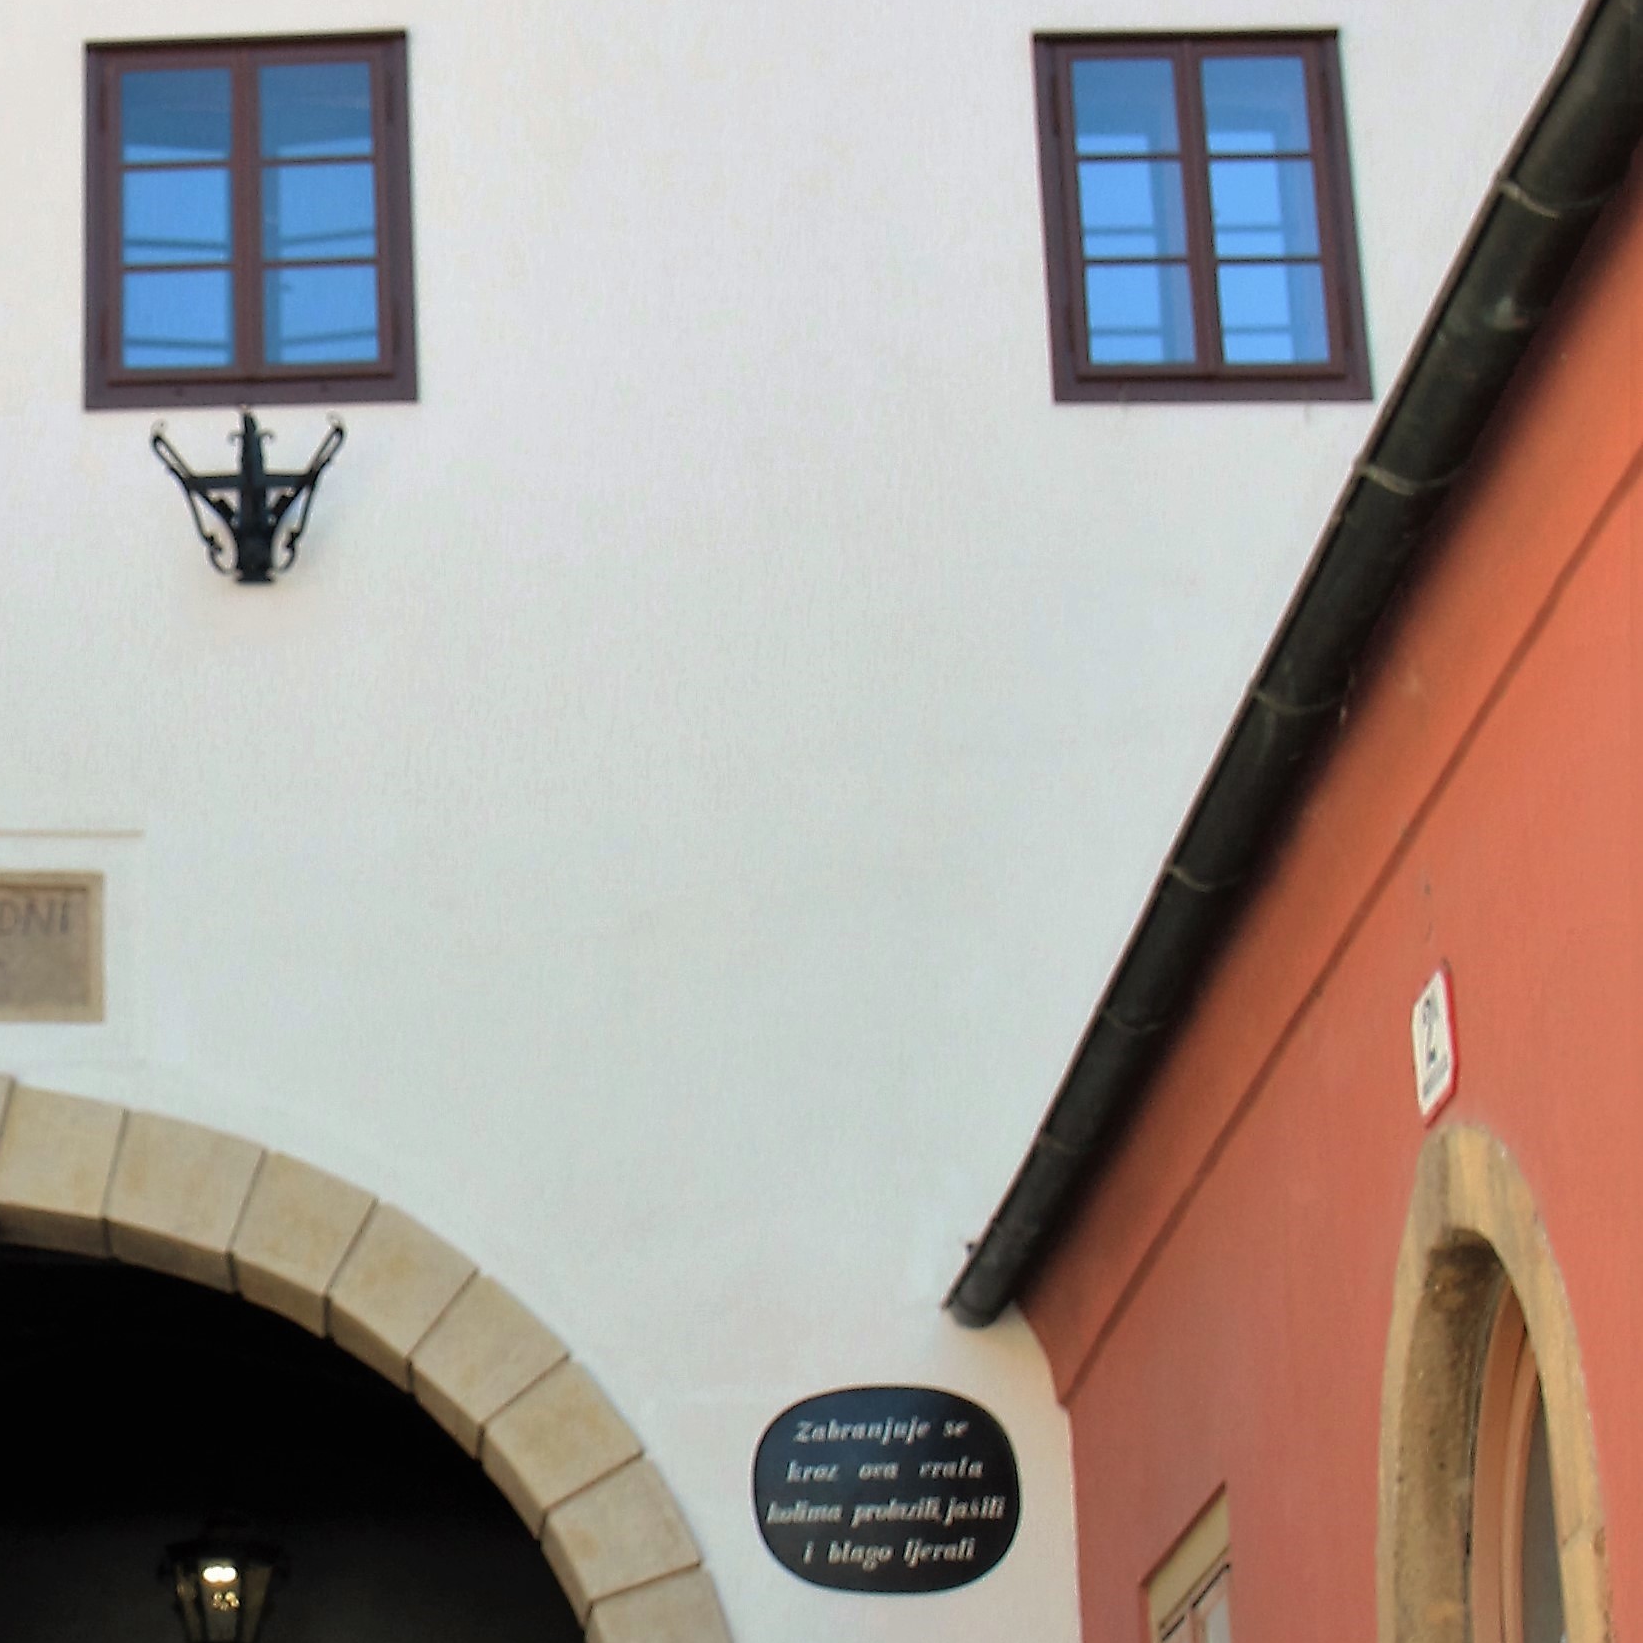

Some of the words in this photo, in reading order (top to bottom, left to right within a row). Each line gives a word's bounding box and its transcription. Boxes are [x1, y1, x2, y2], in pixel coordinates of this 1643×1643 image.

[792, 1415, 931, 1445] Zabranjuje
[942, 1419, 970, 1438] se
[786, 1459, 839, 1483] kroz
[858, 1462, 899, 1480] ova
[919, 1455, 983, 1479] vrata
[803, 1540, 814, 1564] i
[827, 1540, 894, 1572] blago
[904, 1536, 976, 1568] tjerati
